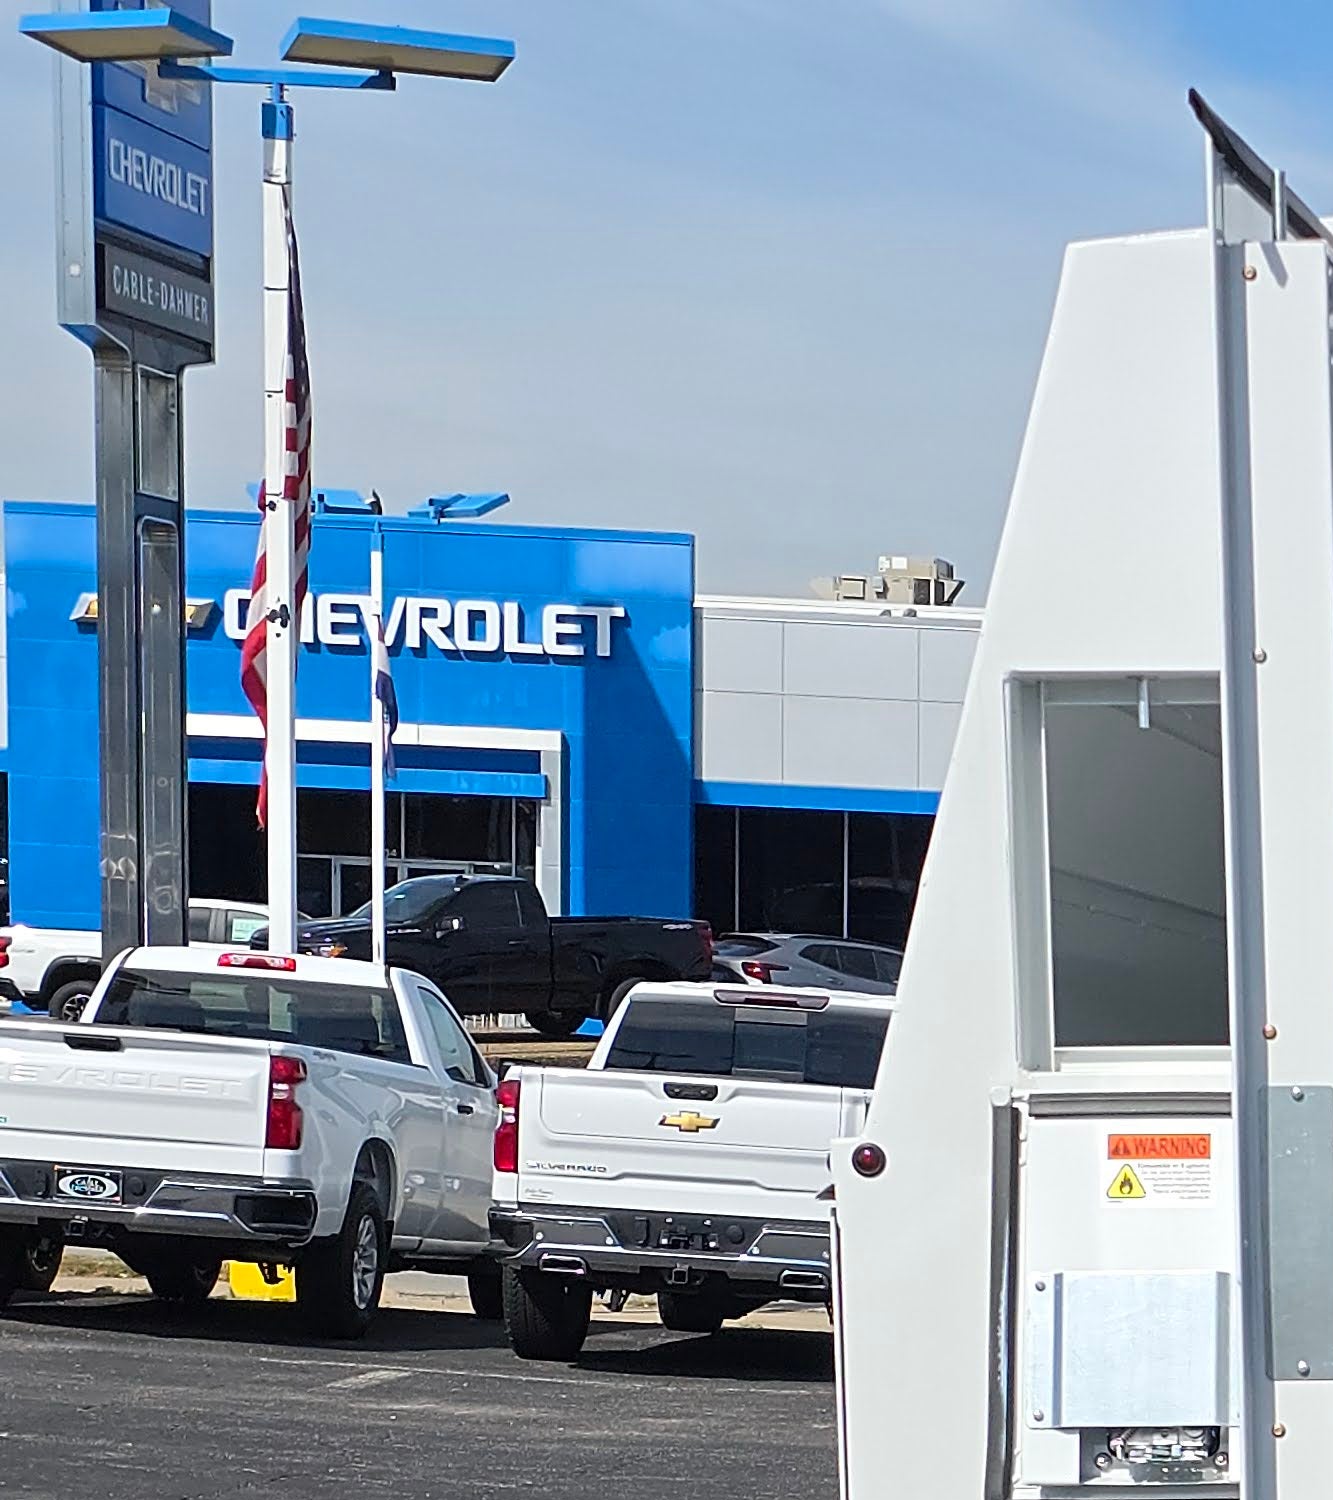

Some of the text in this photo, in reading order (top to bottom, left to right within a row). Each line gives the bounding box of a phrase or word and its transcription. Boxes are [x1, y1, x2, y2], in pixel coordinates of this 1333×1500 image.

[109, 138, 209, 216] CHEVROLET
[112, 265, 209, 326] CABLE-DAHMER
[1133, 1137, 1208, 1156] WARNING
